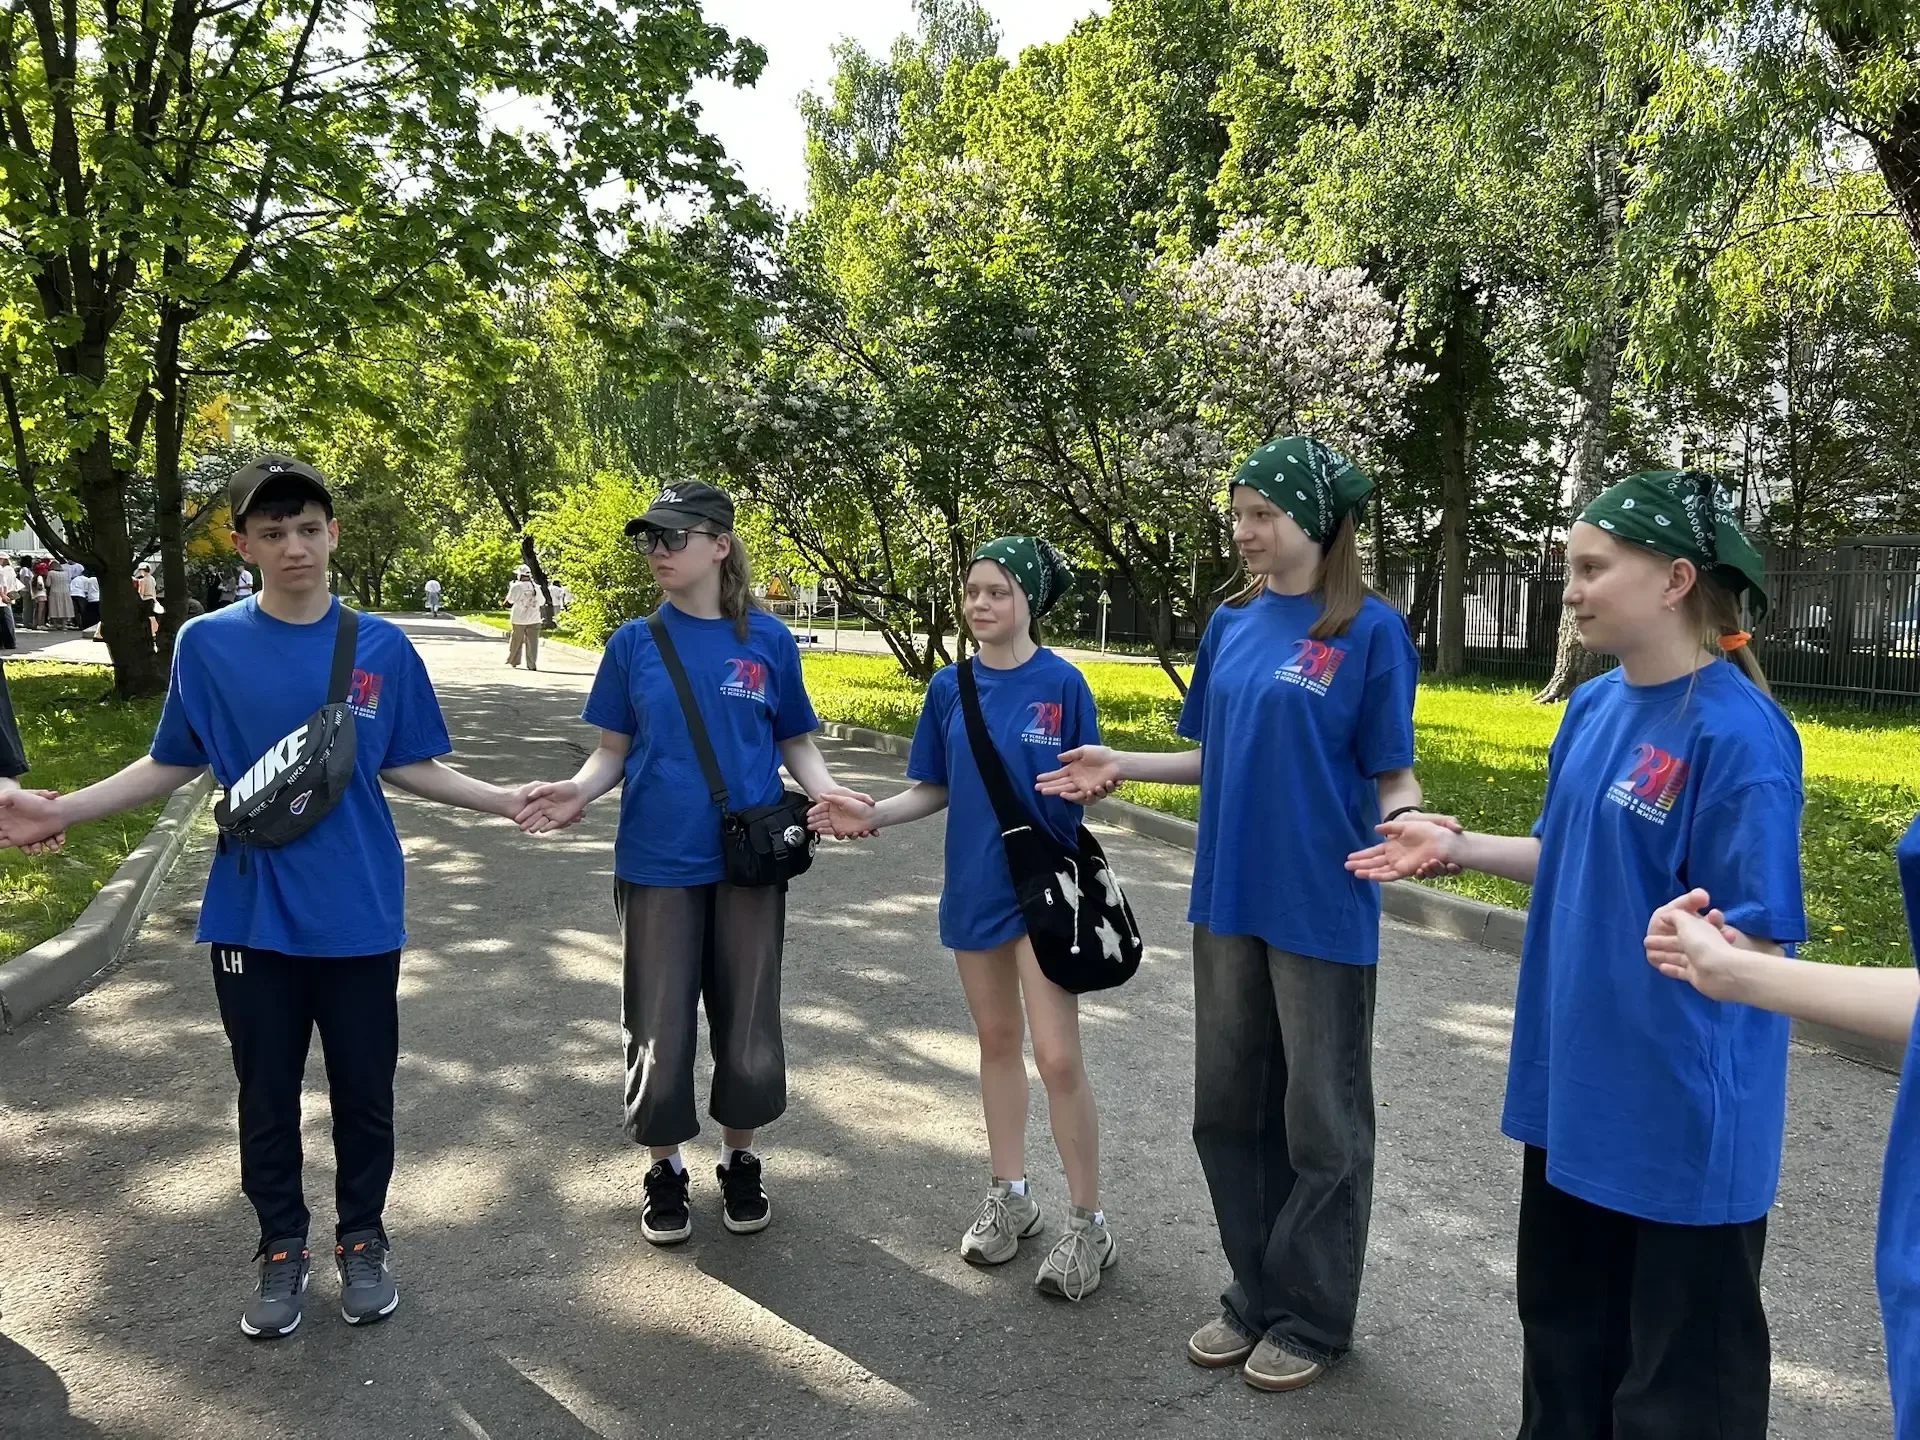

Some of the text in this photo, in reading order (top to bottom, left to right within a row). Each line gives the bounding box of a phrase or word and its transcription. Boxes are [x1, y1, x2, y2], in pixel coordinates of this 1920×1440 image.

[230, 724, 309, 813] NIKE
[286, 764, 307, 786] NIKE
[1613, 743, 1681, 804] 281
[248, 800, 269, 819] NIKE
[1635, 807, 1665, 826] ЖИЗНИ
[1639, 802, 1668, 820] ШКОЛЕ
[221, 949, 244, 974] LH
